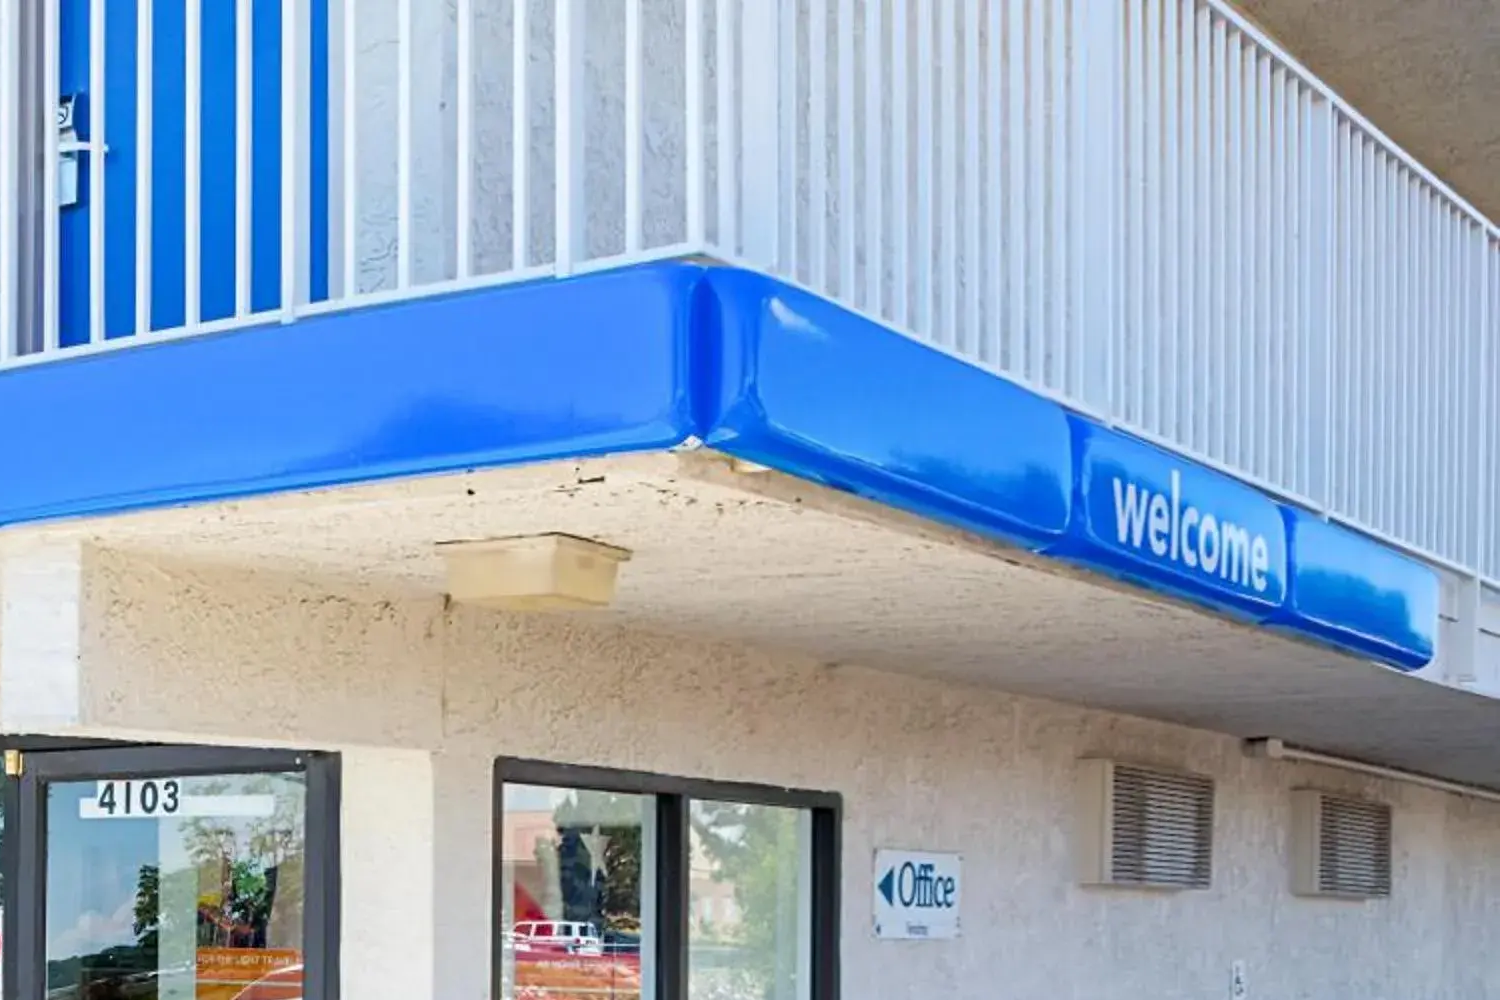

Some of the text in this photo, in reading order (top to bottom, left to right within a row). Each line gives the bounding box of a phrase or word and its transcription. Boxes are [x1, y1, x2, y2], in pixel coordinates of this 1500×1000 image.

[1113, 470, 1269, 592] welcome
[98, 781, 179, 815] 4103
[898, 861, 955, 908] Office
